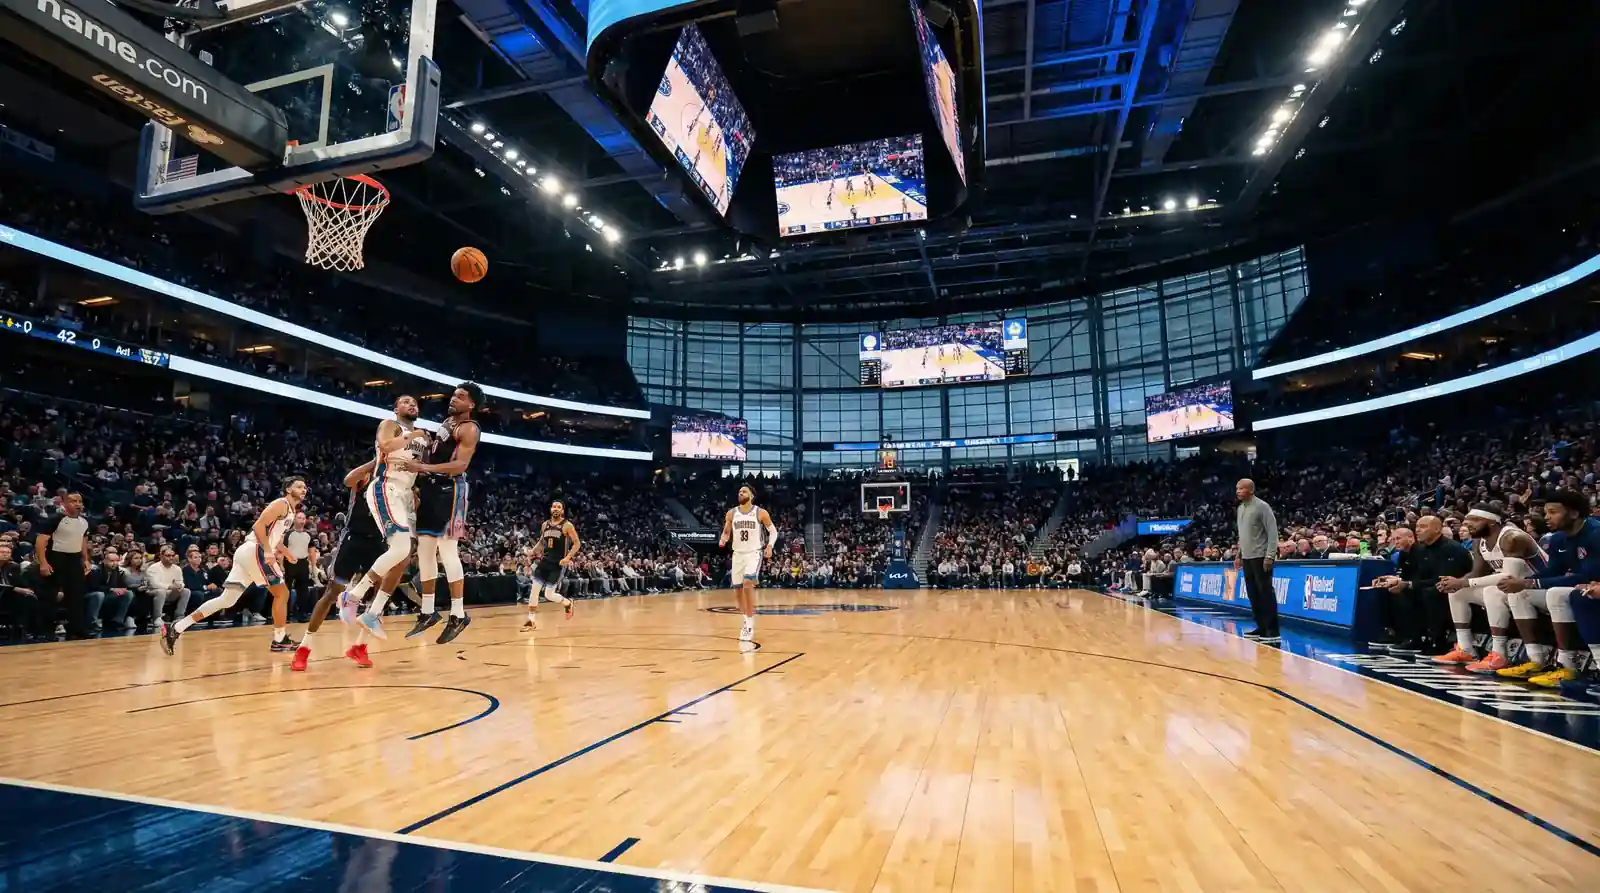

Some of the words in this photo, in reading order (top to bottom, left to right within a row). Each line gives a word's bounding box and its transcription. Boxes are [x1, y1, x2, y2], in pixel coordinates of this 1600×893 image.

[36, 0, 209, 105] name.com
[57, 329, 77, 345] 42
[739, 530, 749, 542] 33
